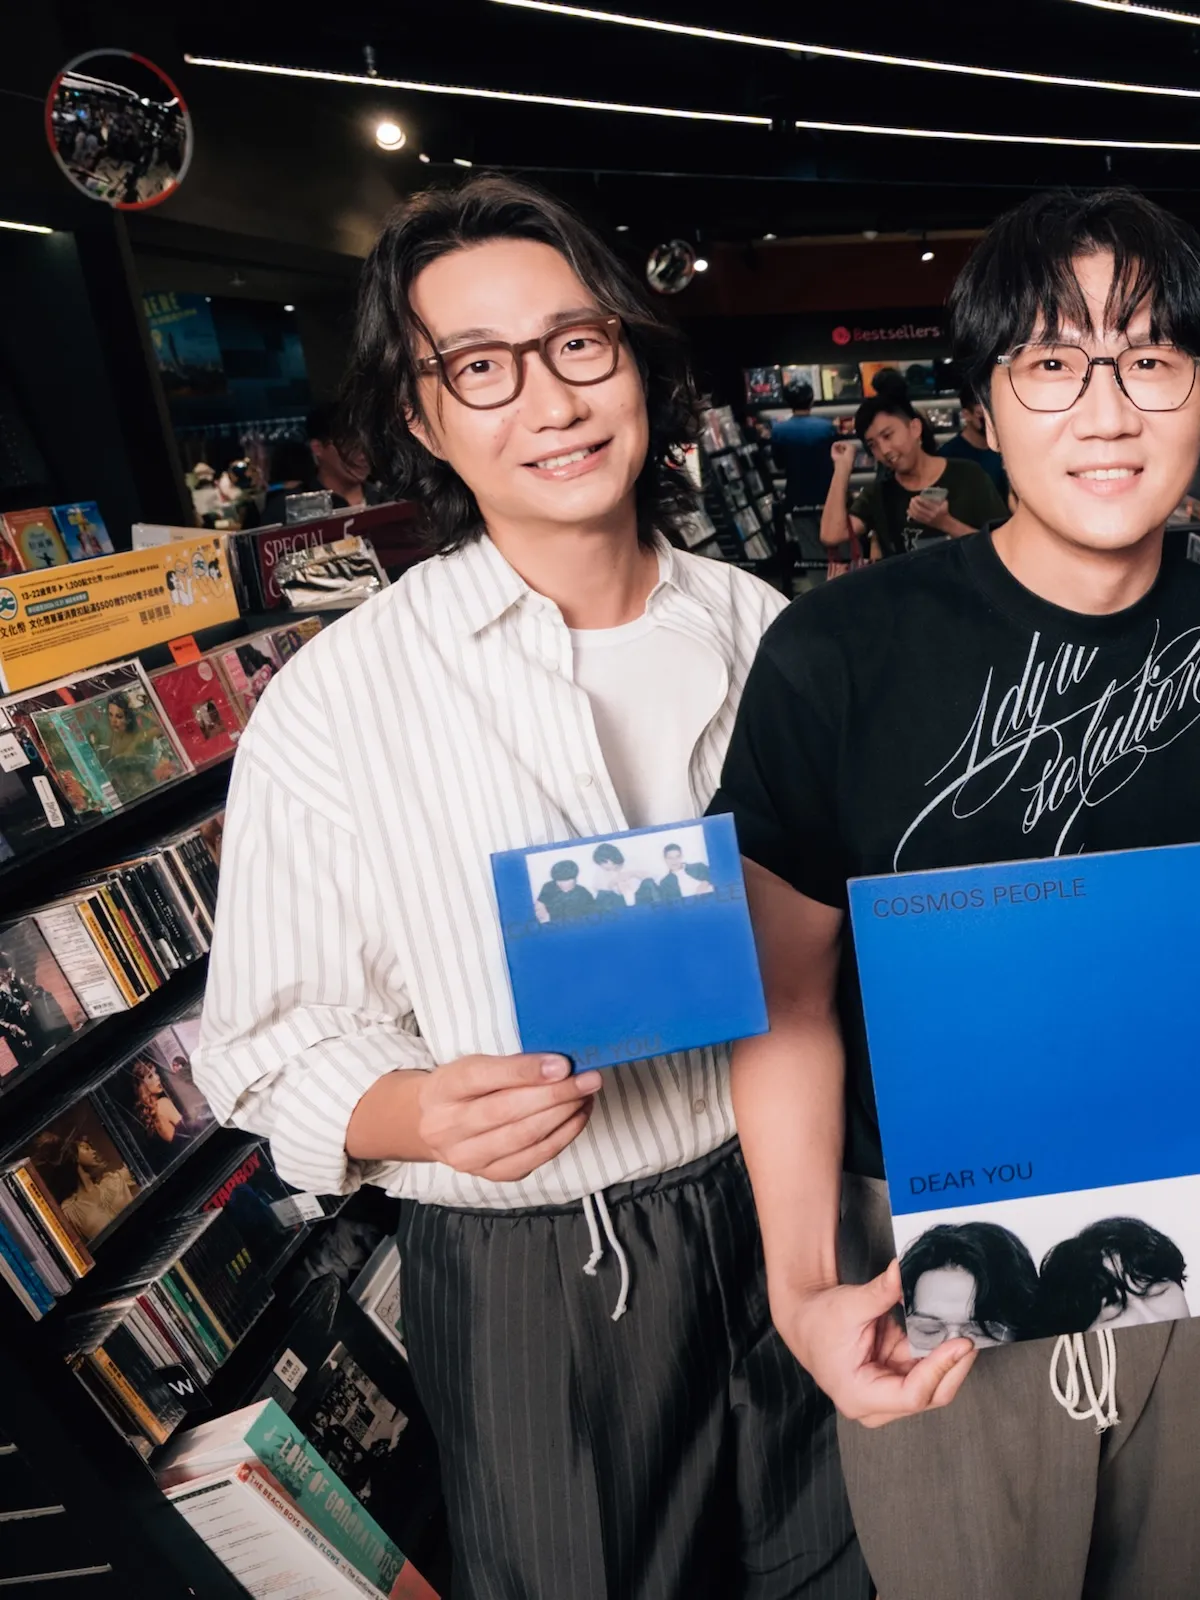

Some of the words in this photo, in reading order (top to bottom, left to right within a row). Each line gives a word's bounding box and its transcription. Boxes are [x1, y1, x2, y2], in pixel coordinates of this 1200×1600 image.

[854, 325, 940, 341] Bestsellers
[873, 888, 985, 918] COSMOS
[993, 878, 1087, 905] PEOPLE
[910, 1169, 975, 1195] DEAR
[982, 1161, 1033, 1184] YOU
[168, 1378, 195, 1396] W
[279, 1437, 315, 1481] LOVE
[308, 1470, 330, 1496] OF
[262, 1484, 284, 1511] BEACH
[283, 1508, 301, 1528] BOYS
[304, 1527, 320, 1547] FEEL
[318, 1542, 341, 1566] FLOWS
